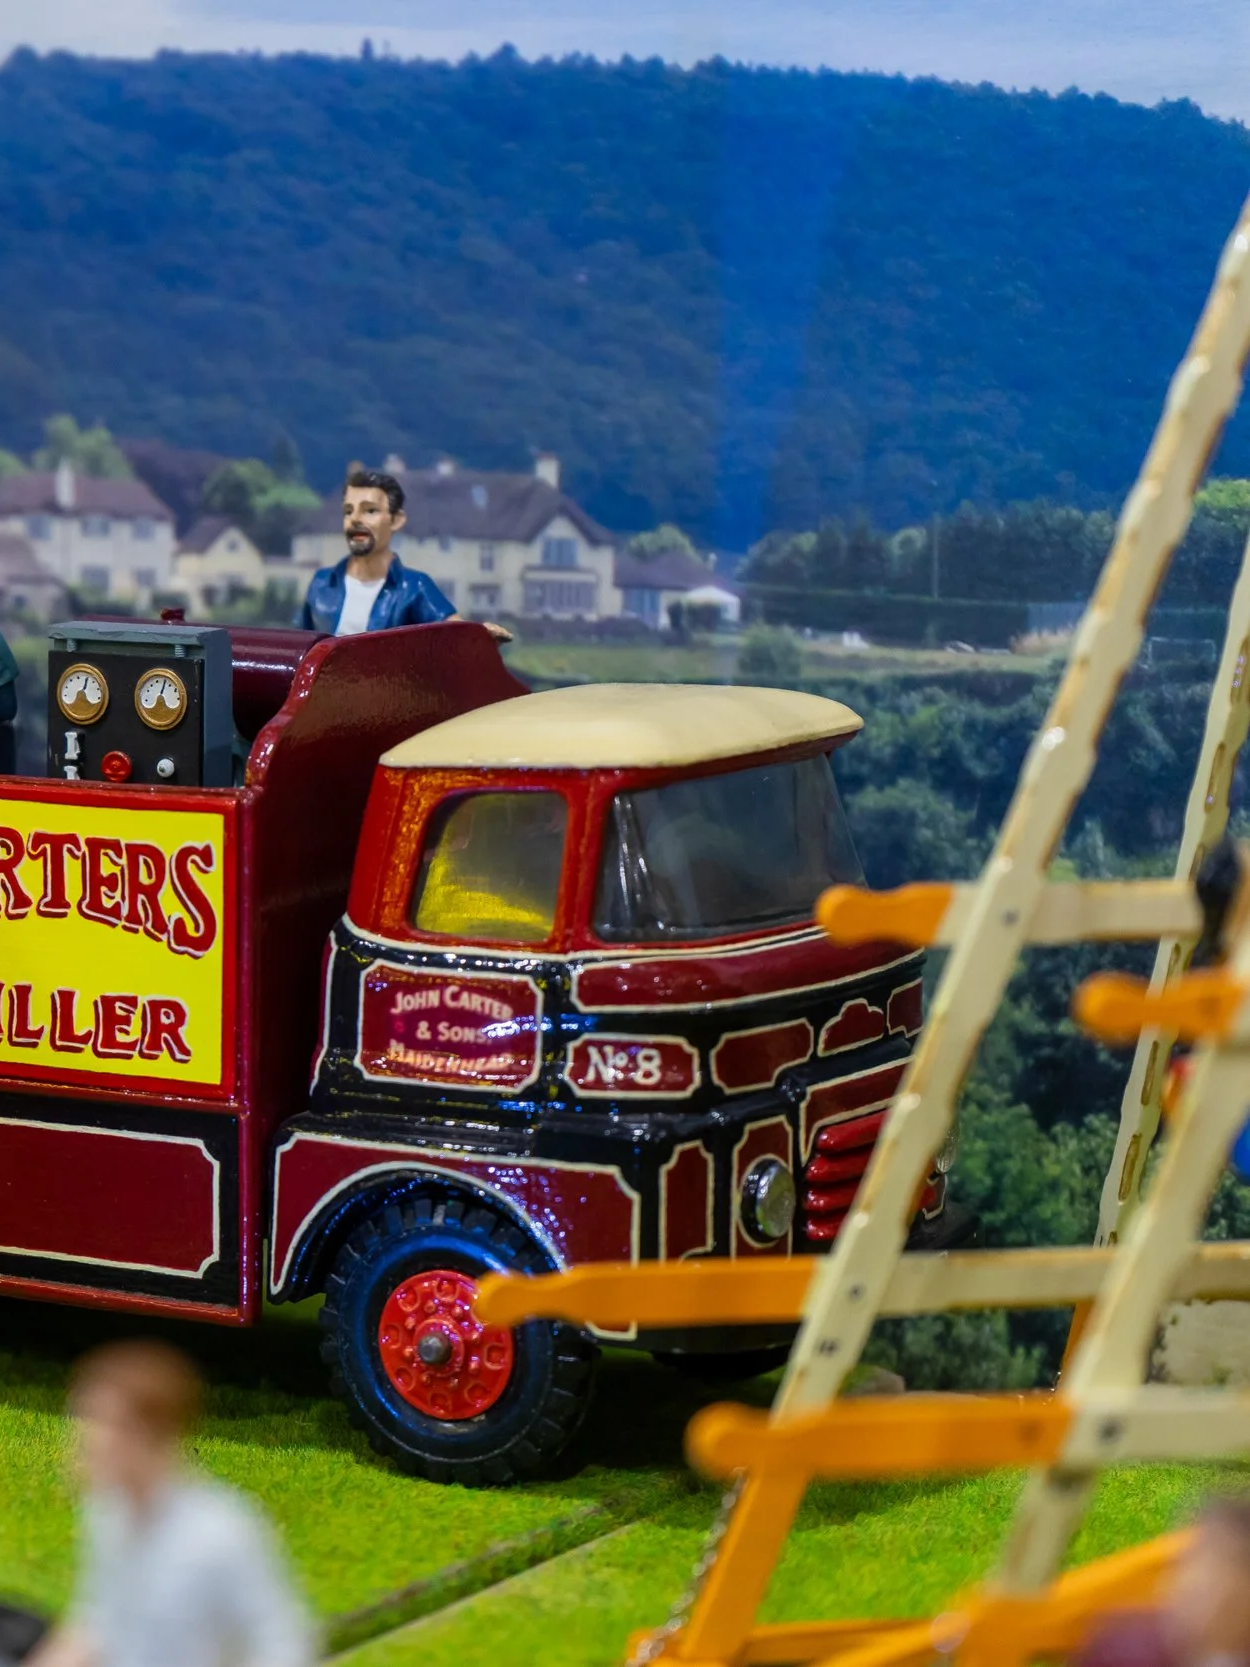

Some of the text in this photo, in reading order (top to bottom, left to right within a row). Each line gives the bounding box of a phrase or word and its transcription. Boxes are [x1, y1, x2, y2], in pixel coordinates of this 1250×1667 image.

[390, 985, 513, 1019] JOHN CARTER
[415, 1020, 432, 1040] &
